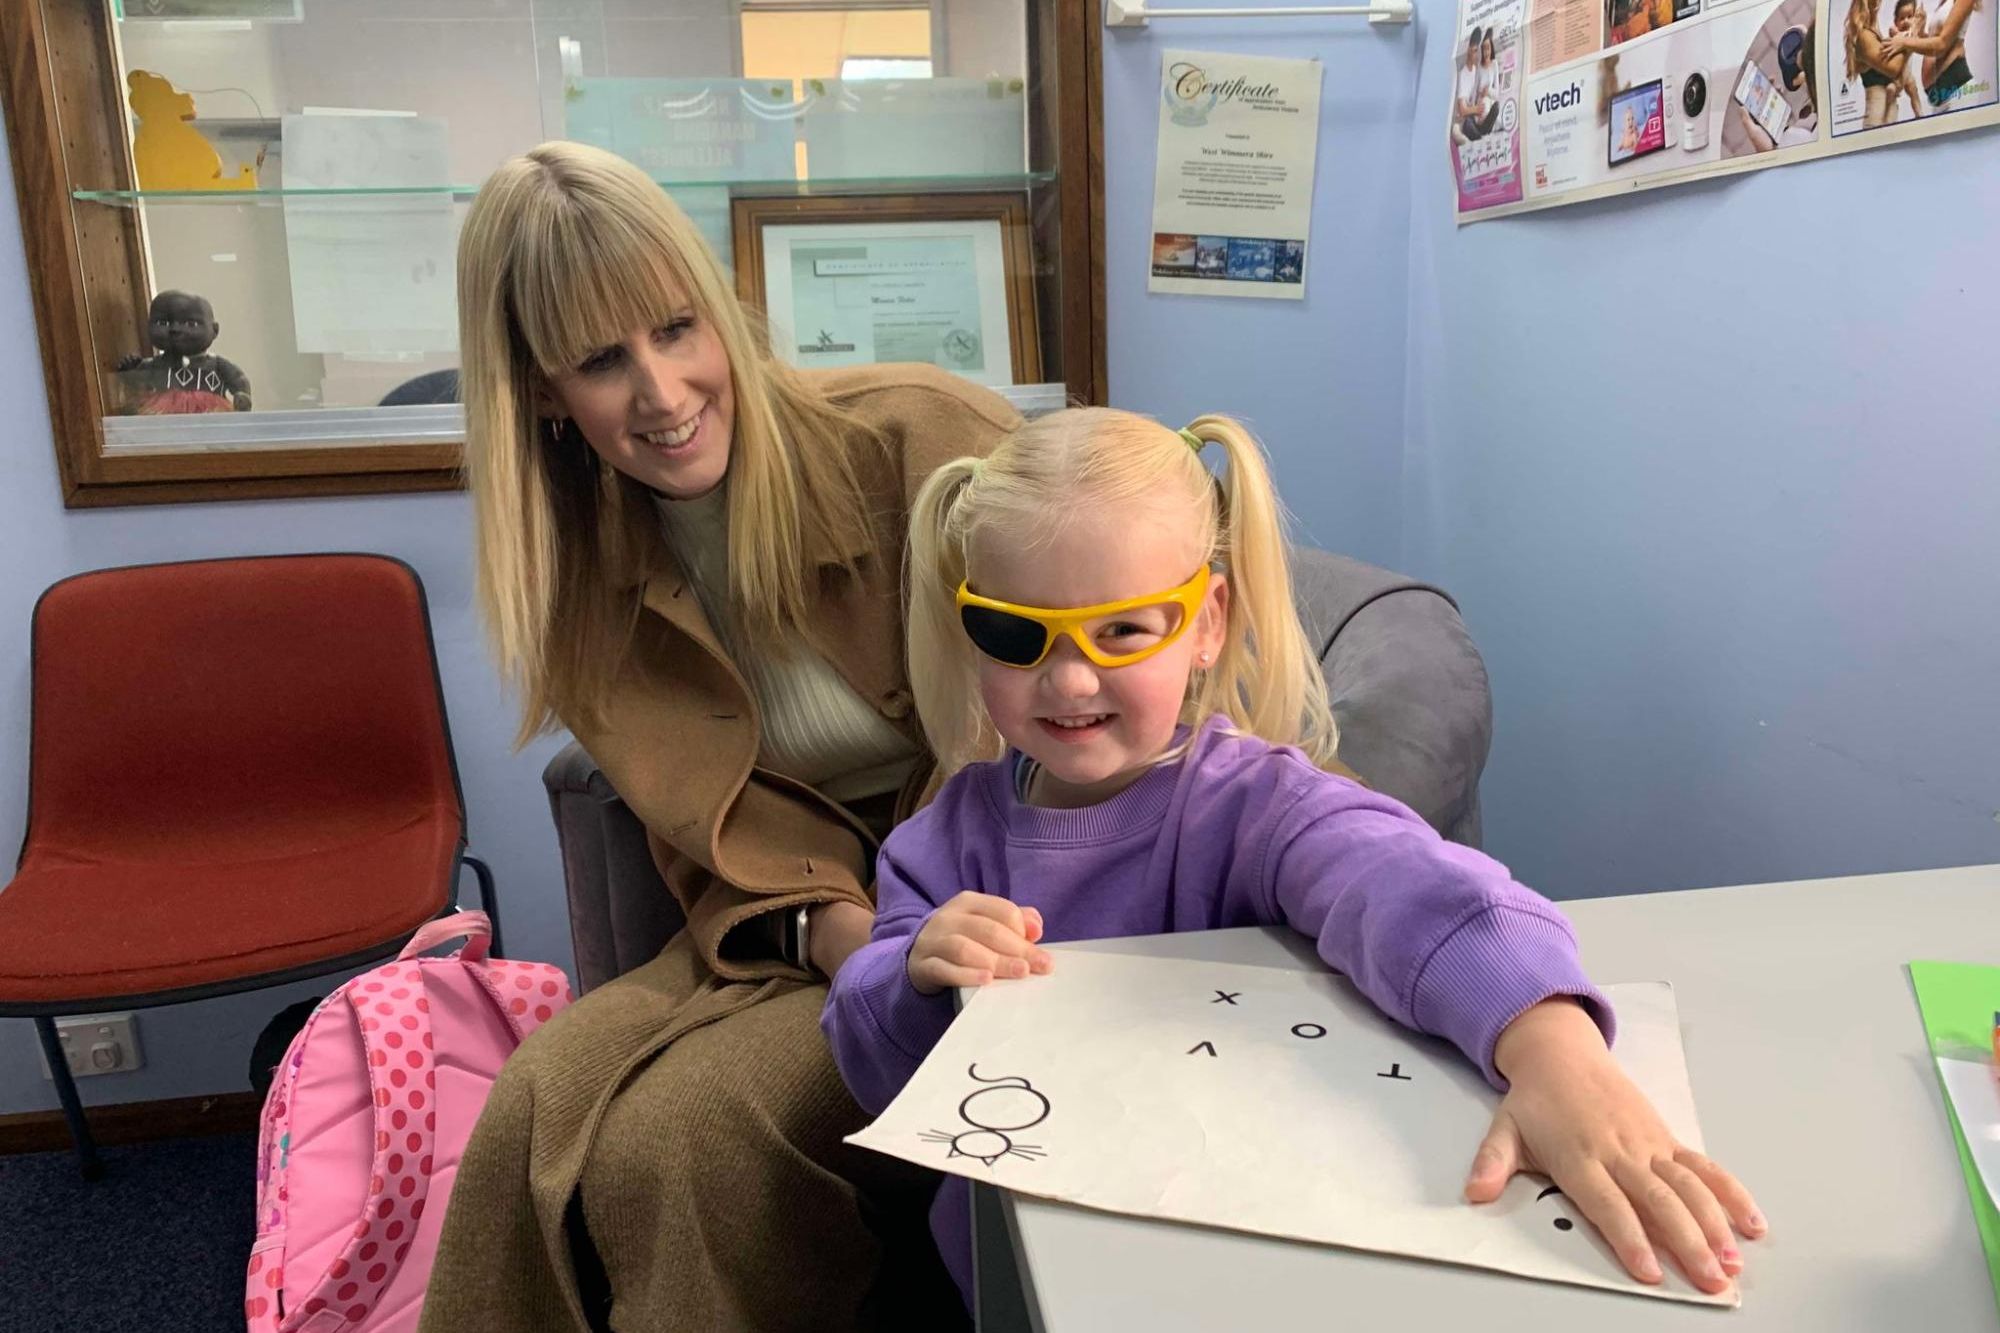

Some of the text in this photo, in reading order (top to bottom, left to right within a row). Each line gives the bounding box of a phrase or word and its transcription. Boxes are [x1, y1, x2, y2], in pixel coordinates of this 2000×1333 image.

[1169, 62, 1280, 104] Certificate
[1535, 82, 1581, 115] vtech
[1291, 1023, 1327, 1039] O
[1377, 1063, 1412, 1080] T
